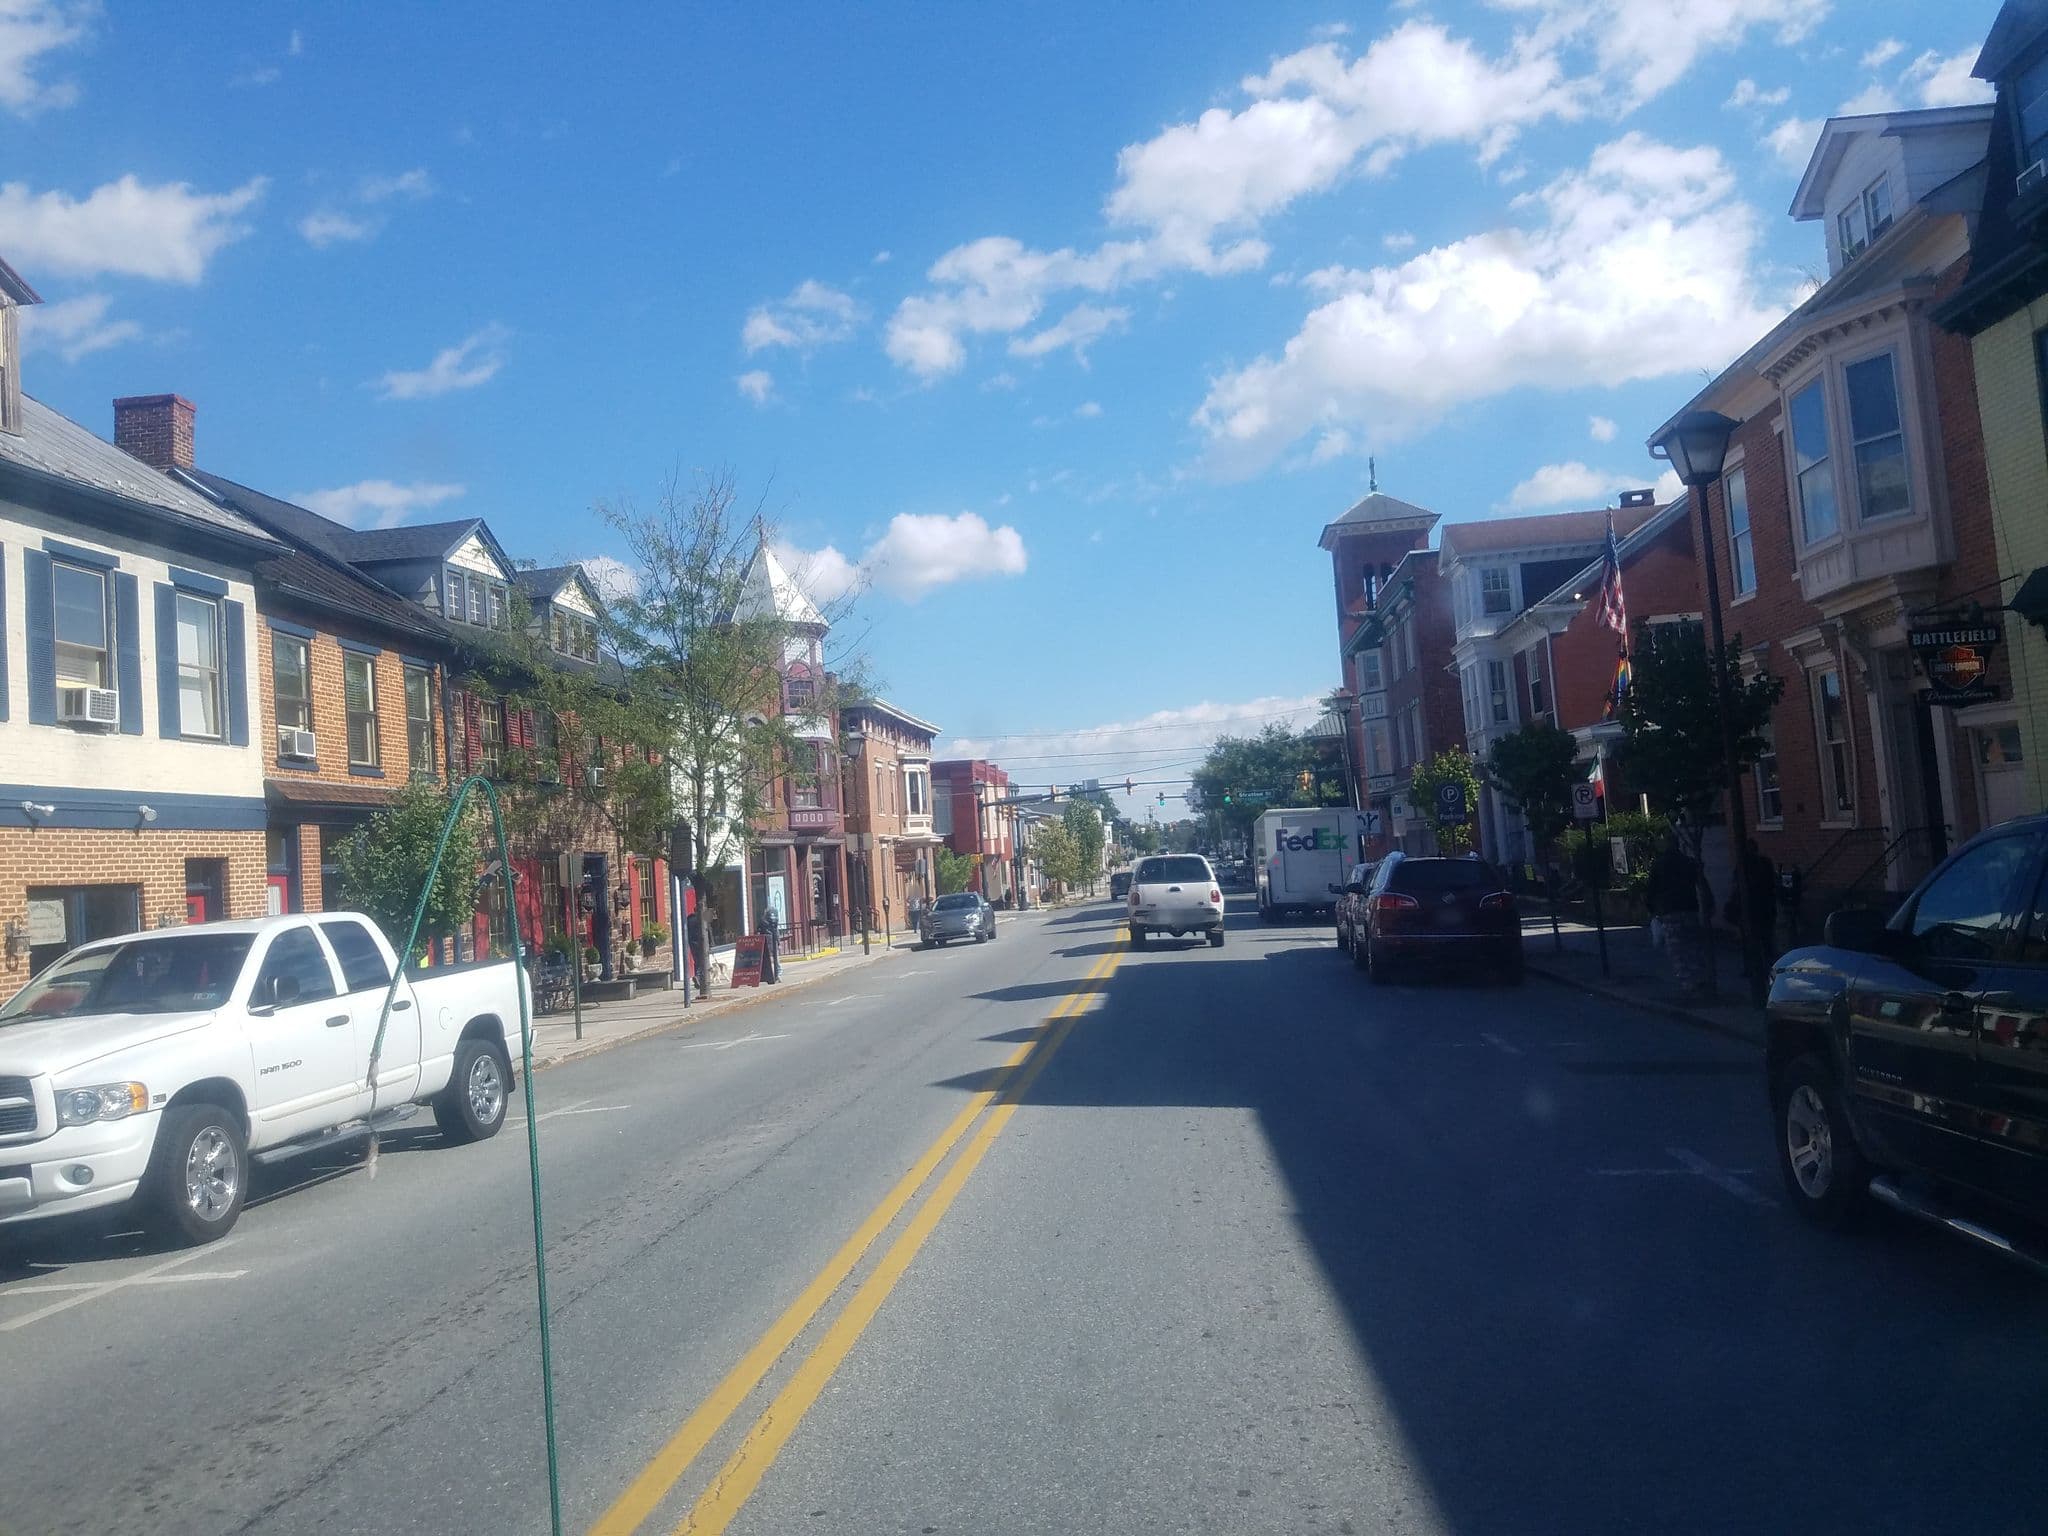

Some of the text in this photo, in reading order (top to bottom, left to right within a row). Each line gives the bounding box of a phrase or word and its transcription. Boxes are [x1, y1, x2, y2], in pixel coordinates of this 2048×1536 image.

[1912, 630, 1996, 645] BATTLEFIELD
[1275, 827, 1349, 851] FedEx
[260, 1059, 302, 1075] RAM 1500
